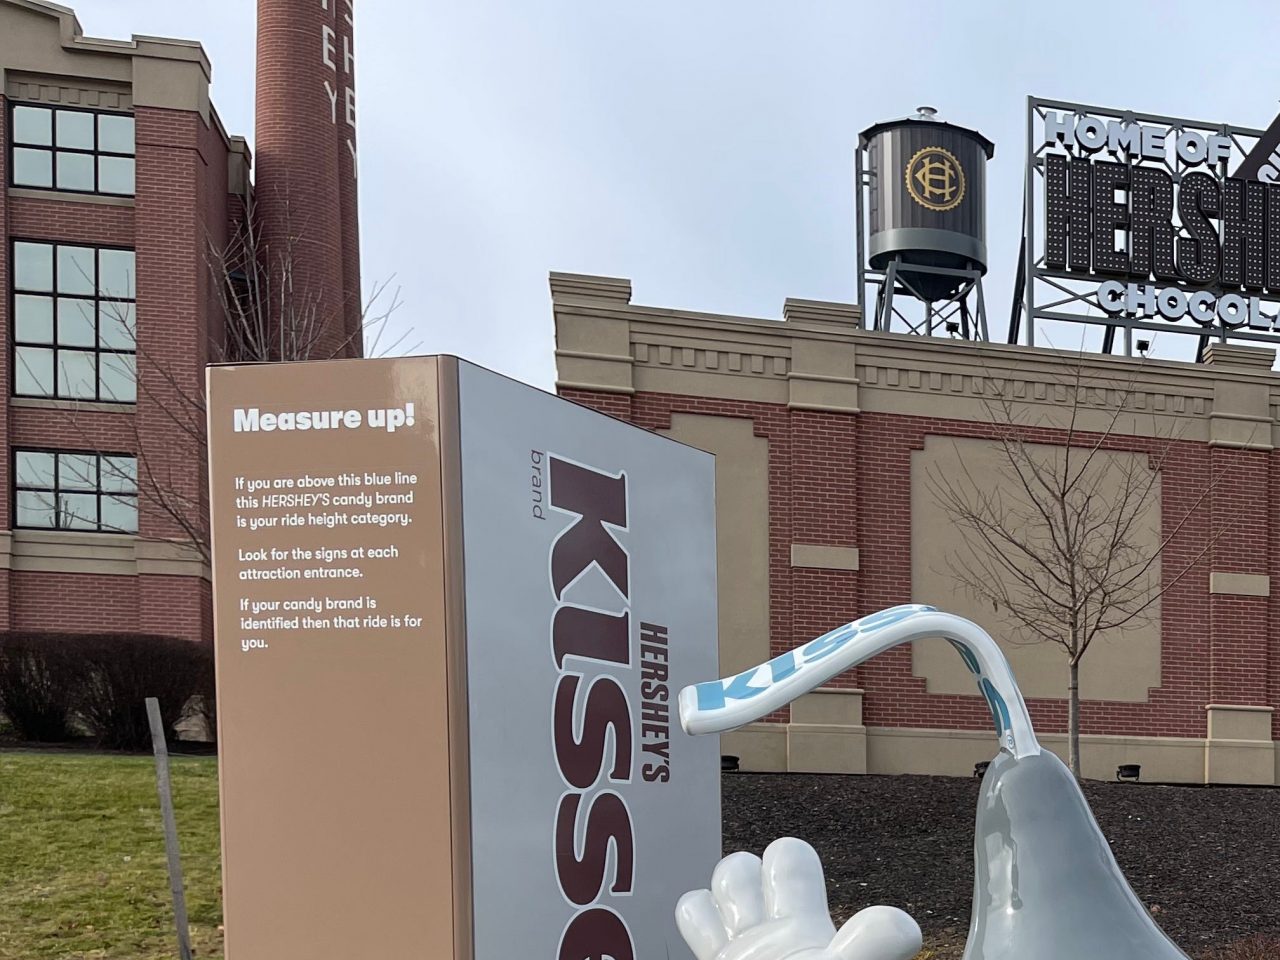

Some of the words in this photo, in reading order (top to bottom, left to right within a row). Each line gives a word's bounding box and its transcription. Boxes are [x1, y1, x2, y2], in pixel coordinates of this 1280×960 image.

[1044, 111, 1166, 160] HOME
[1176, 131, 1231, 168] OF
[233, 408, 362, 432] Measure
[367, 402, 415, 433] up!
[235, 477, 244, 490] If
[247, 479, 271, 492] you
[273, 478, 294, 488] are
[297, 475, 335, 487] above
[338, 473, 361, 486] this
[364, 472, 392, 485] blue
[394, 472, 417, 485] line
[531, 449, 546, 520] brand
[235, 496, 259, 509] this
[262, 493, 330, 508] HERSHEY'S
[332, 492, 372, 507] candy
[376, 491, 414, 504] brand
[237, 515, 247, 527] is
[250, 516, 278, 530] your
[281, 514, 305, 526] ride
[308, 512, 348, 528] height
[351, 512, 412, 527] category.
[238, 548, 267, 561] Look
[271, 547, 288, 560] for
[292, 547, 312, 560] the
[315, 546, 348, 563] signs
[350, 547, 365, 558] at
[367, 545, 398, 558] each
[239, 566, 301, 580] attraction
[303, 566, 364, 579] entrance.
[240, 598, 249, 611] If
[252, 600, 280, 614] your
[283, 597, 322, 613] candy
[325, 596, 363, 610] brand
[366, 596, 377, 609] is
[240, 616, 299, 630] identified
[302, 616, 330, 629] then
[333, 615, 360, 628] that
[363, 615, 387, 628] ride
[390, 615, 401, 627] is
[404, 614, 422, 627] for
[241, 638, 269, 652] you.
[640, 621, 670, 783] HERSHEY'S
